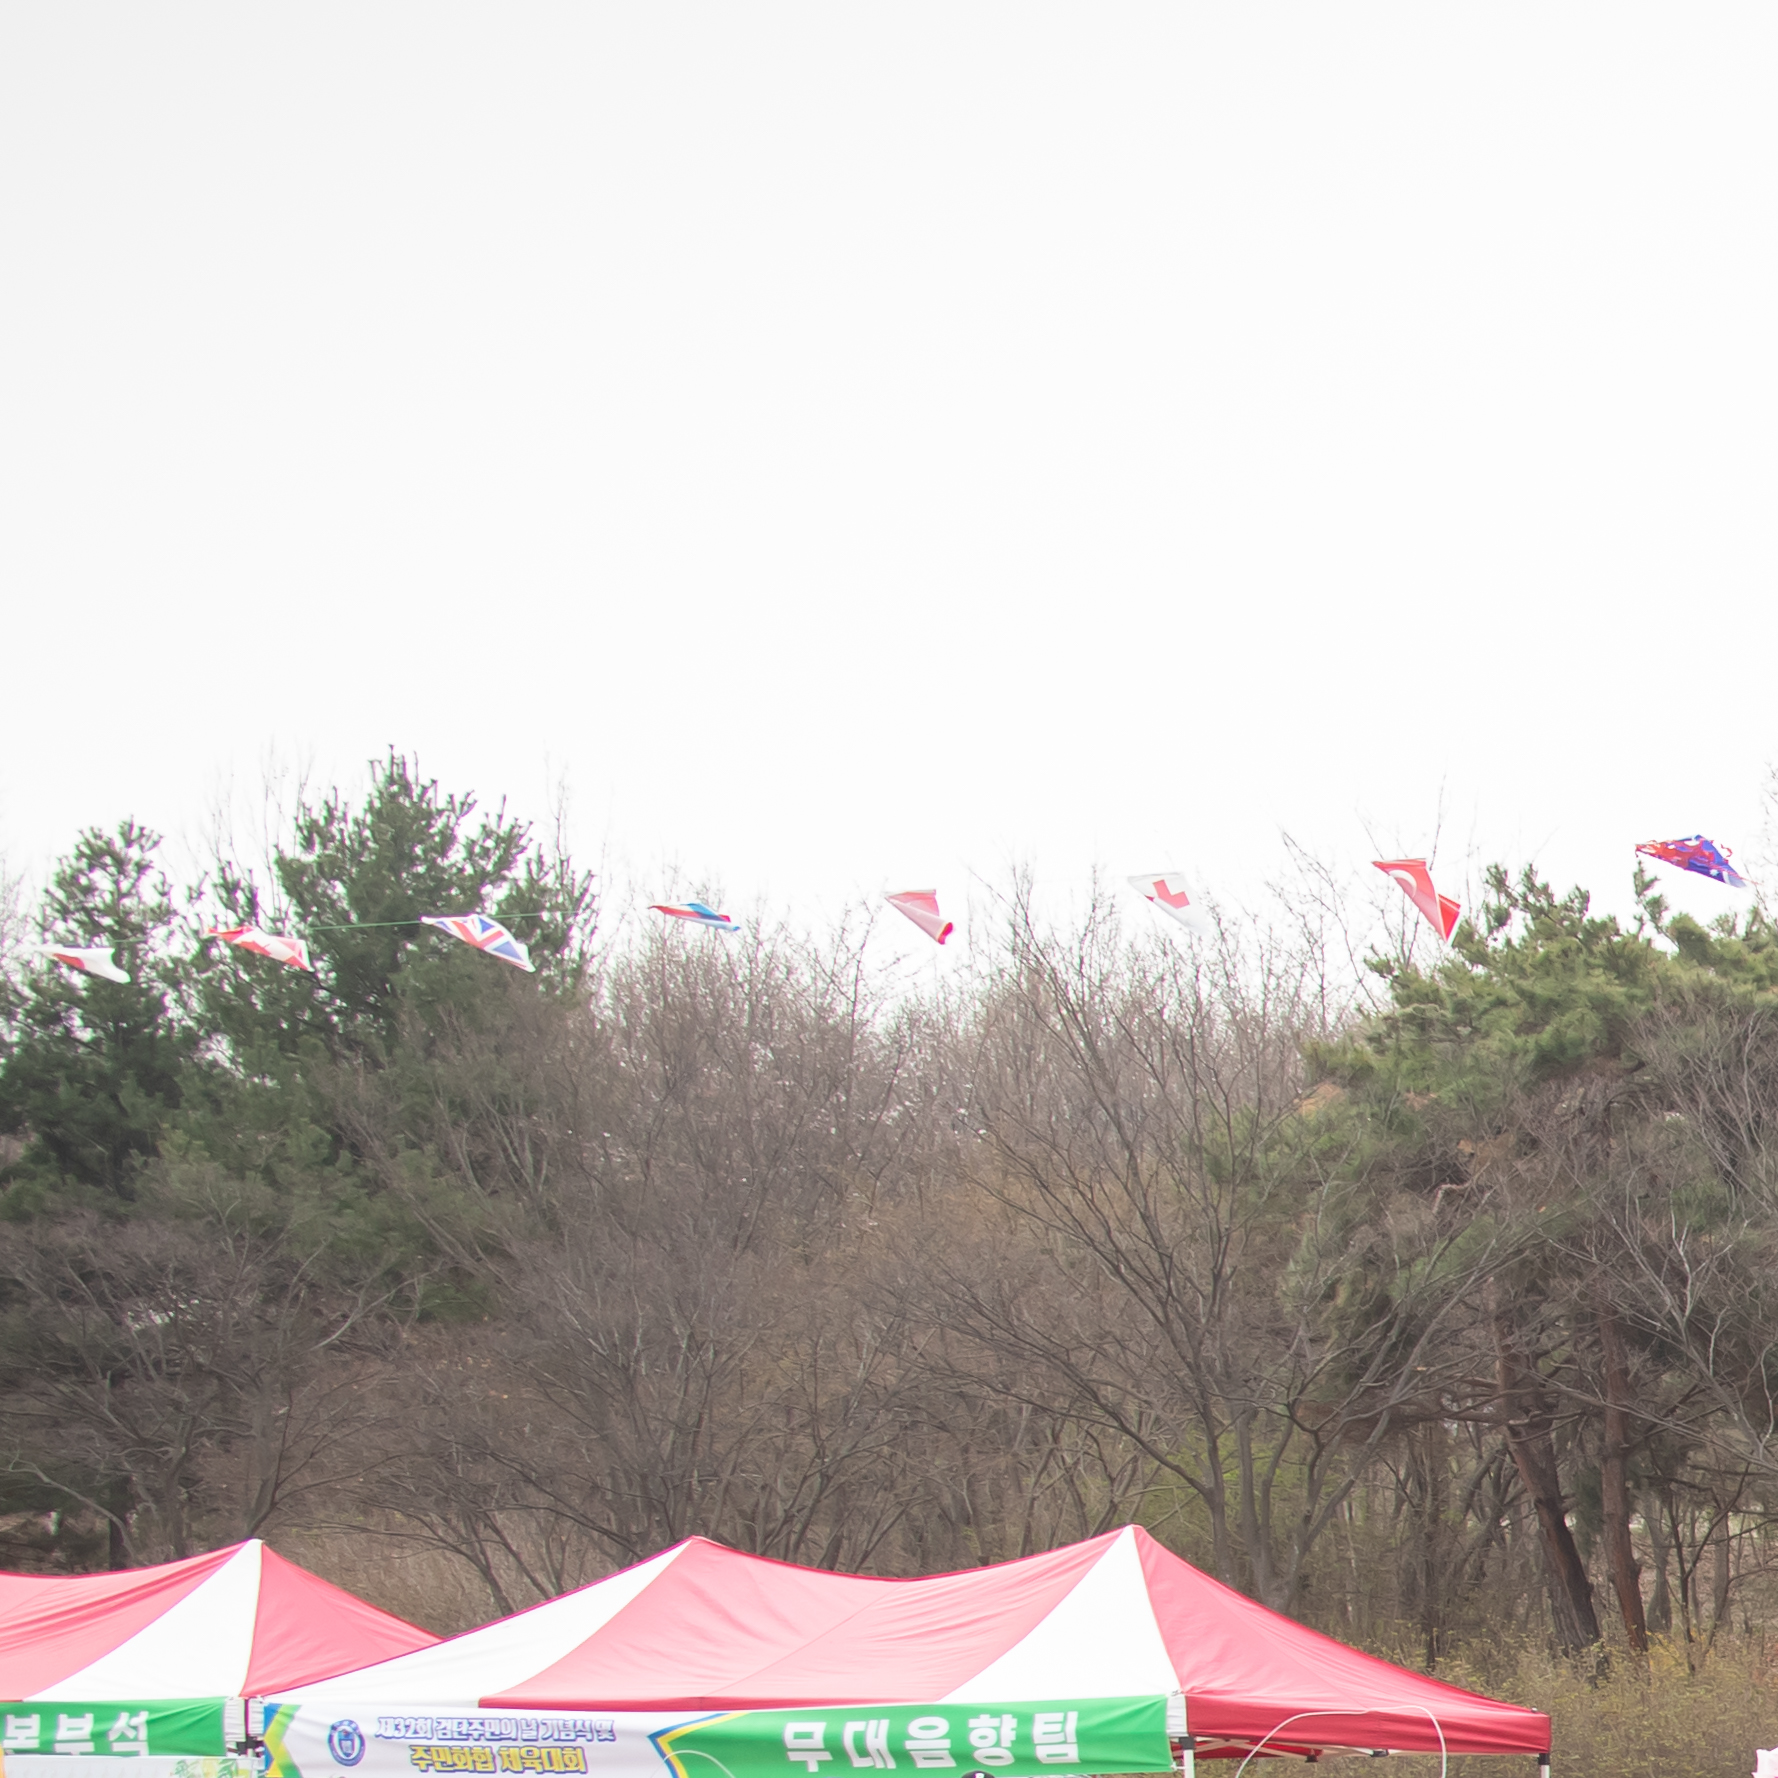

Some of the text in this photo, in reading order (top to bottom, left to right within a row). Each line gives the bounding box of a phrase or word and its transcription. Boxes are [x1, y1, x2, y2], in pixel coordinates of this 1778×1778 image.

[376, 1717, 616, 1741] 제32회 검단주민의 날 기념식 및
[783, 1711, 1081, 1772] 무대음향팀
[410, 1746, 588, 1773] 주민화합 체육대회
